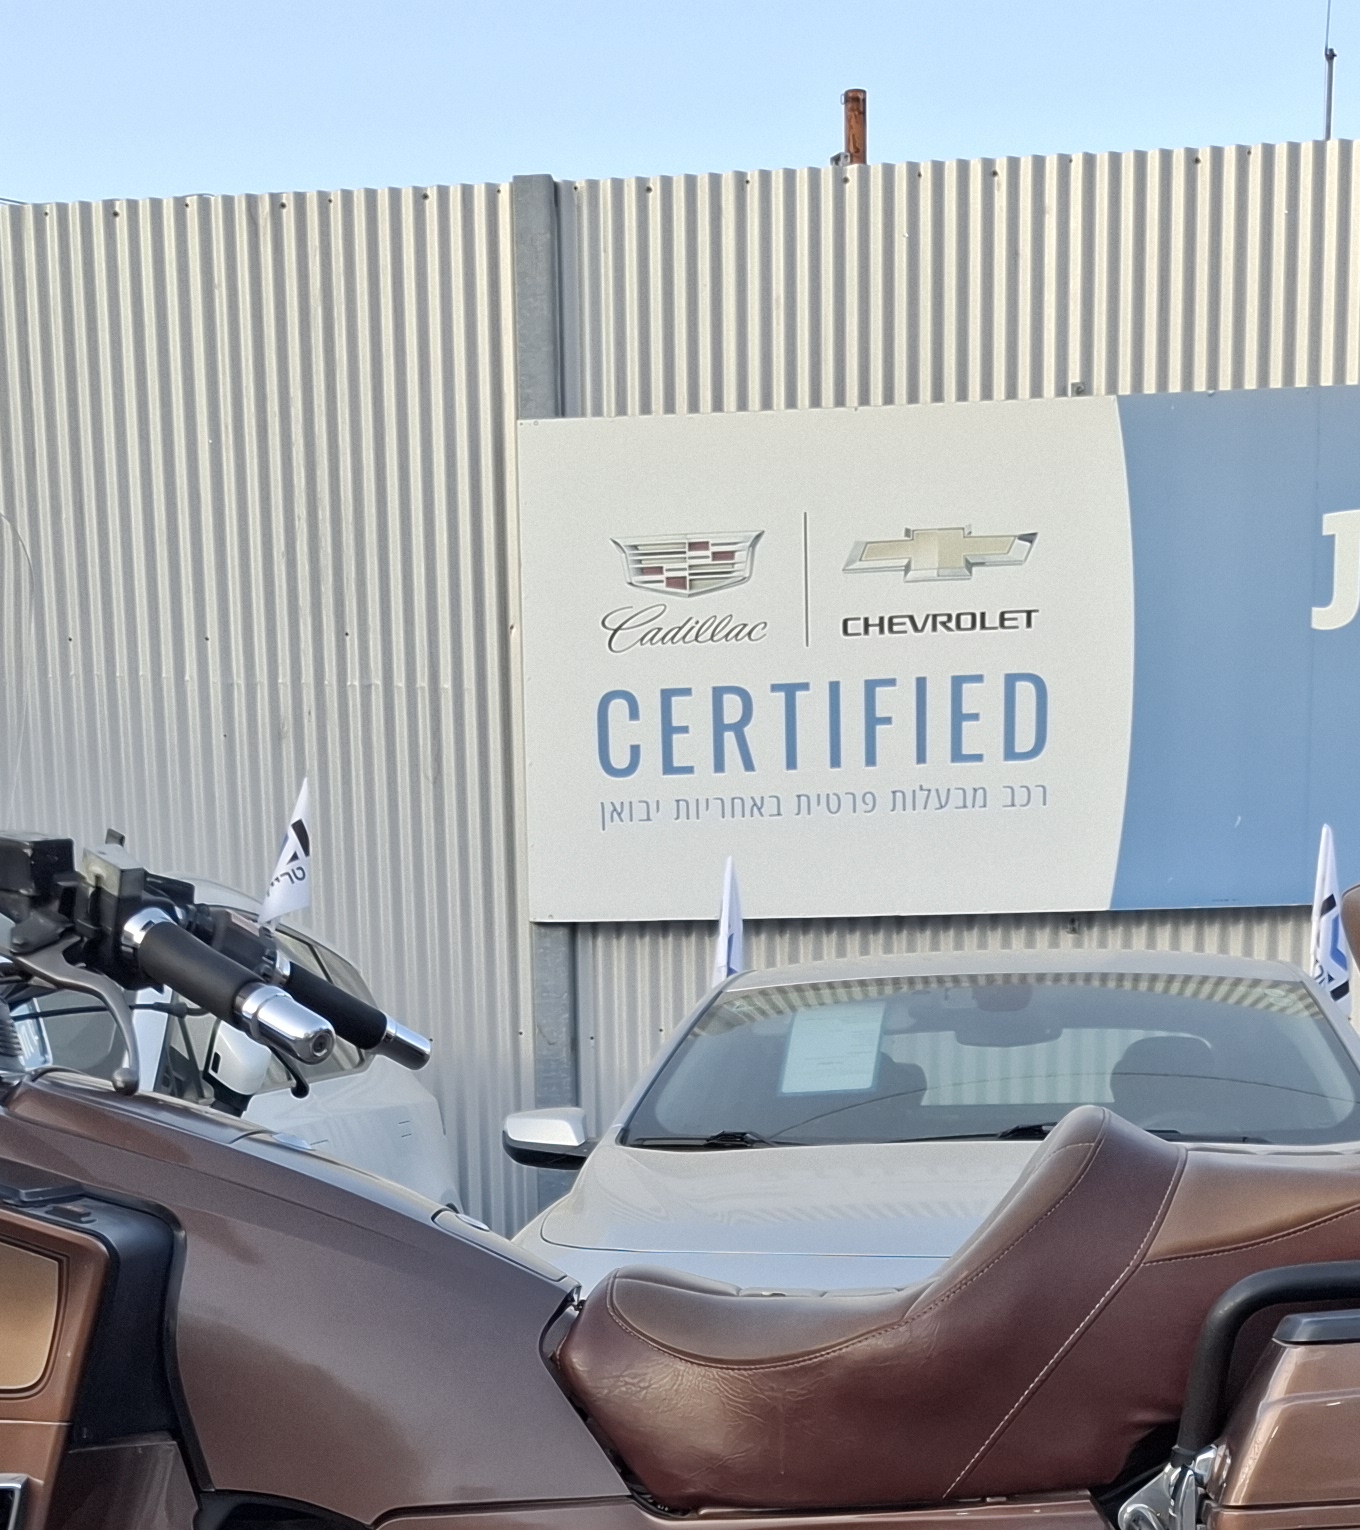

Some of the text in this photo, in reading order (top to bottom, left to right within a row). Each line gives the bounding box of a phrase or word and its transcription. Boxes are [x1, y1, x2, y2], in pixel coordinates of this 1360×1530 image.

[600, 603, 768, 653] Cadillac
[842, 609, 1040, 637] CHEVROLET
[596, 672, 1049, 779] CERTIFIED
[599, 783, 1048, 832] רכב מבעלות פרטית באחריות יבואן
